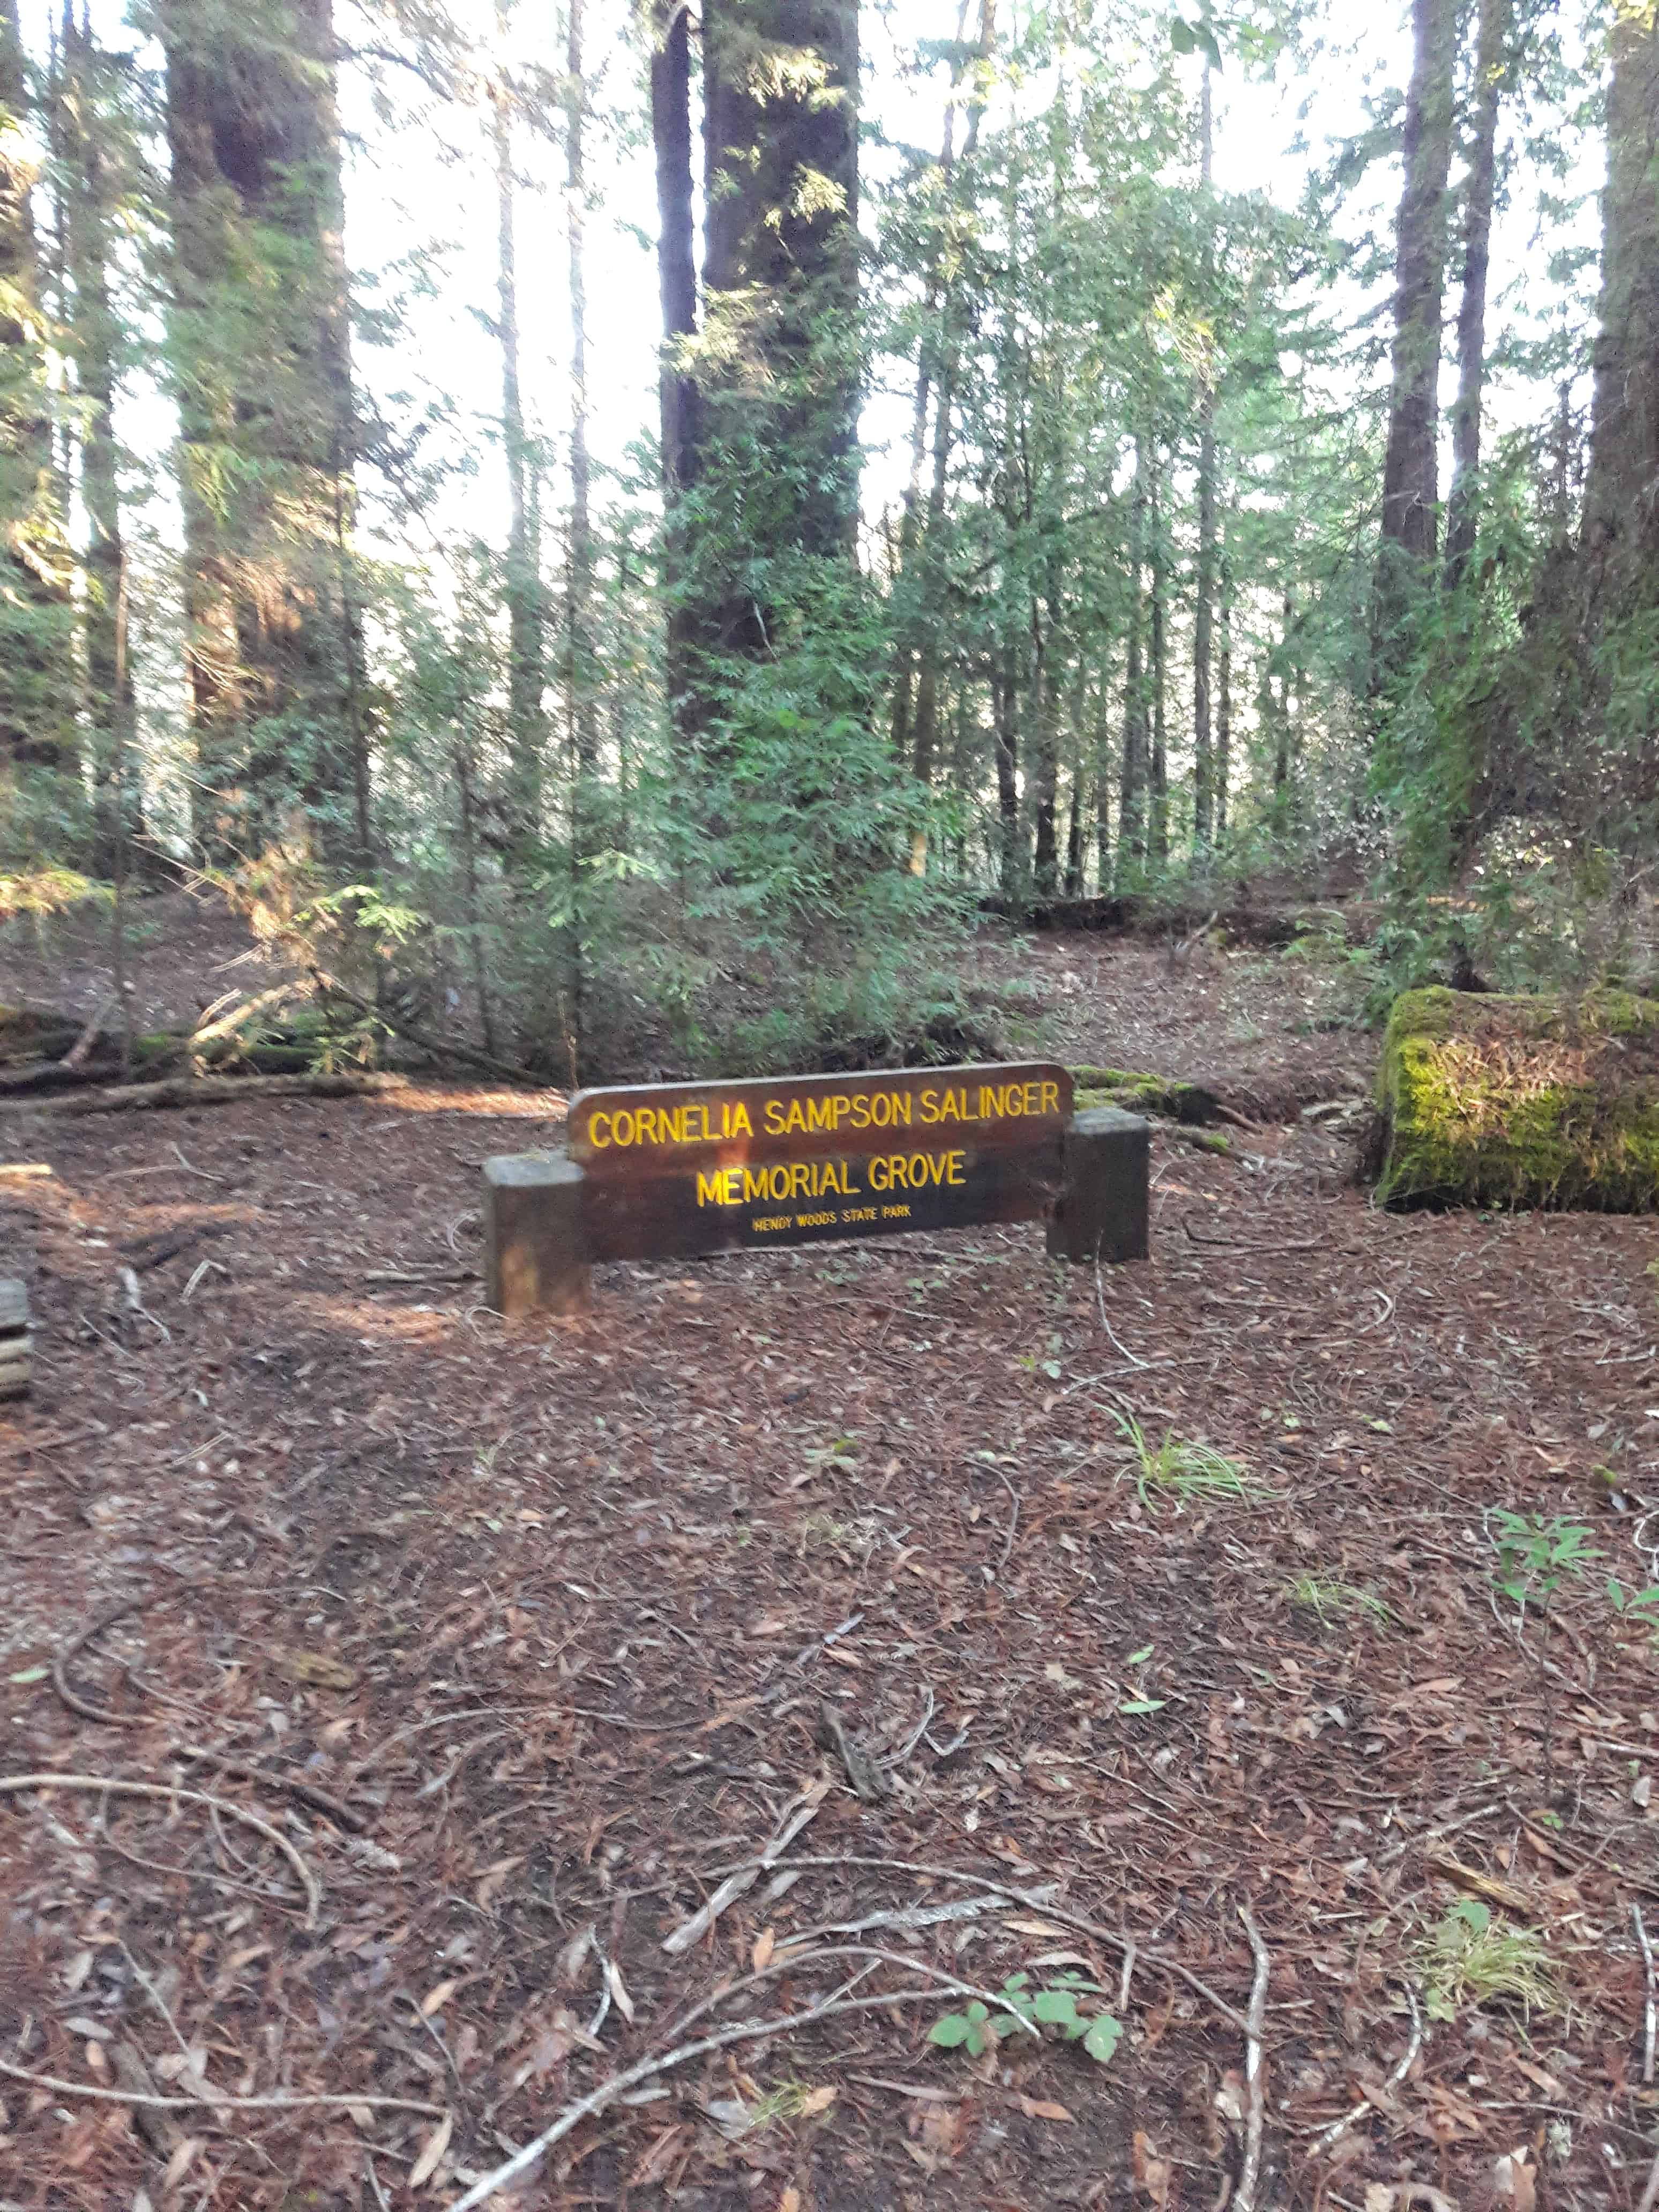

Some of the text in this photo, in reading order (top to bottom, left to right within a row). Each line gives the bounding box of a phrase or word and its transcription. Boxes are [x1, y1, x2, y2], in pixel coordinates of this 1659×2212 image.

[589, 1081, 1059, 1148] CORNELIA SAMPSON SALINGER
[697, 1149, 966, 1207] MEMORIAL GROVE
[753, 1204, 911, 1231] HENDY WOODS STATE PARK
